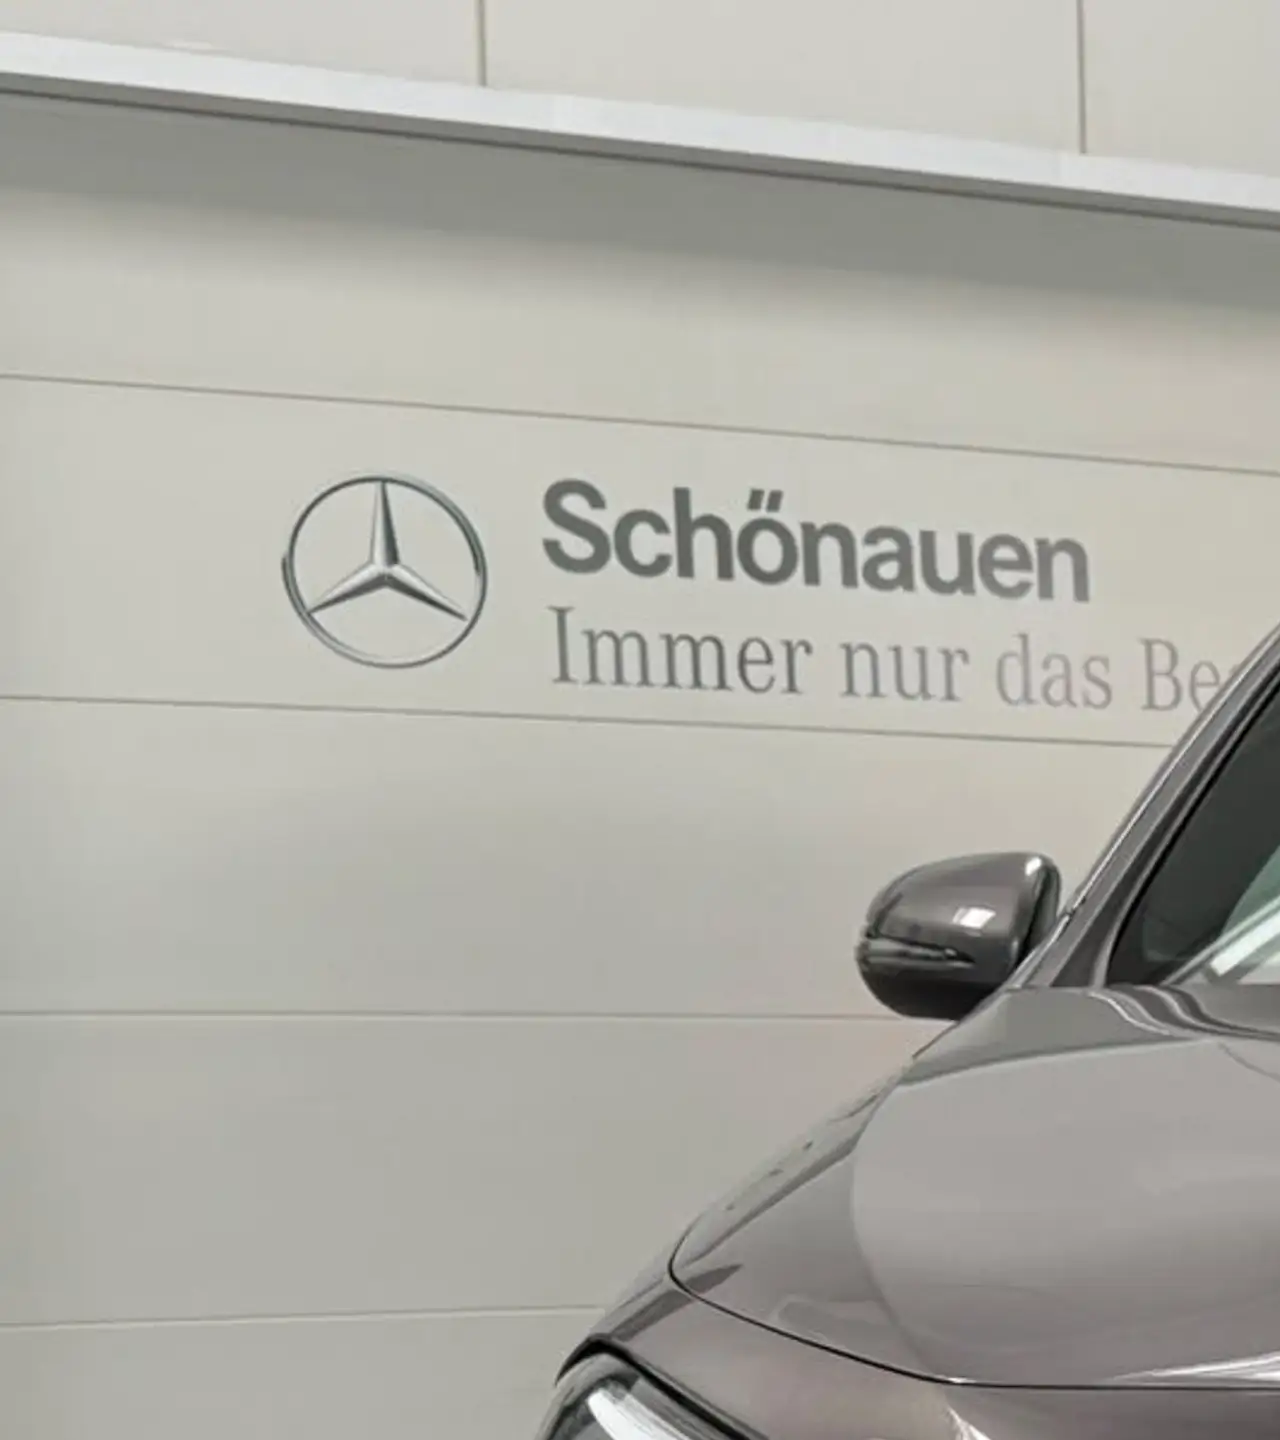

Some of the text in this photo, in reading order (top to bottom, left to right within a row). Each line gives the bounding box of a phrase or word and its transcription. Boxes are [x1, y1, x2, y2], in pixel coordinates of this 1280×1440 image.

[543, 479, 1090, 602] Schönauen
[546, 604, 1240, 713] Immer nur das Be
